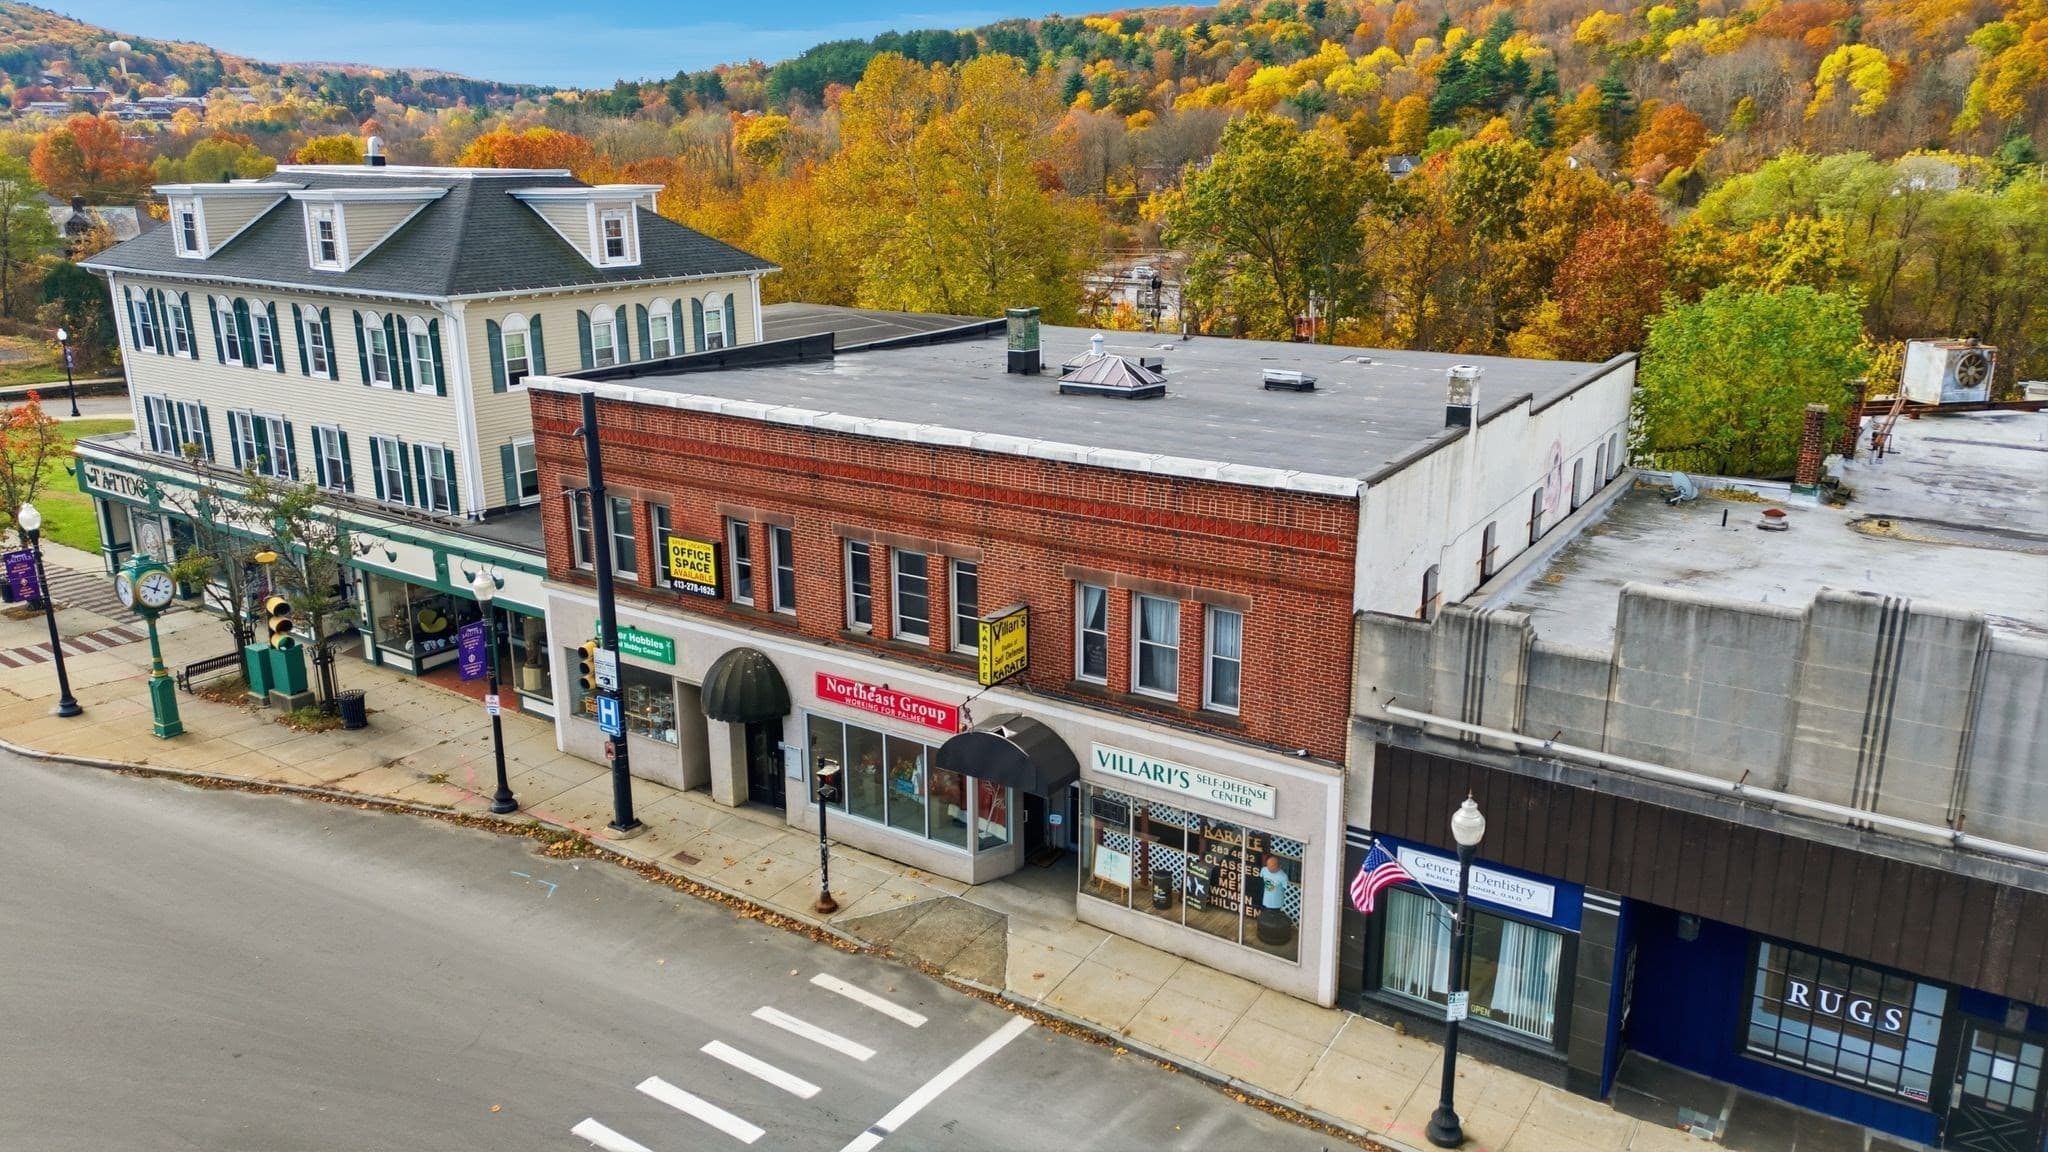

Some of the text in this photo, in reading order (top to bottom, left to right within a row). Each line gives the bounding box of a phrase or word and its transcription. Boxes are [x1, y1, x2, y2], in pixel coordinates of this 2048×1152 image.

[90, 467, 146, 499] TATTOO
[672, 546, 712, 563] OFFICE
[675, 557, 711, 574] SPACE
[673, 568, 714, 583] AVAILABLE
[629, 632, 664, 650] Hobbies
[993, 656, 1025, 680] KARATE
[826, 677, 946, 724] Northeast Group
[845, 696, 926, 724] WORKING FOR PALMER
[601, 700, 617, 726] H
[1097, 750, 1269, 801] VILLARI'S SELF-DEFENSE
[1211, 789, 1252, 807] CENTER
[1204, 854, 1260, 878] CLASSES
[1415, 856, 1536, 899] Genera Dentistry
[1207, 896, 1261, 918] HILDEN
[1471, 1004, 1490, 1017] OPEN
[1787, 981, 1903, 1031] RUGS
